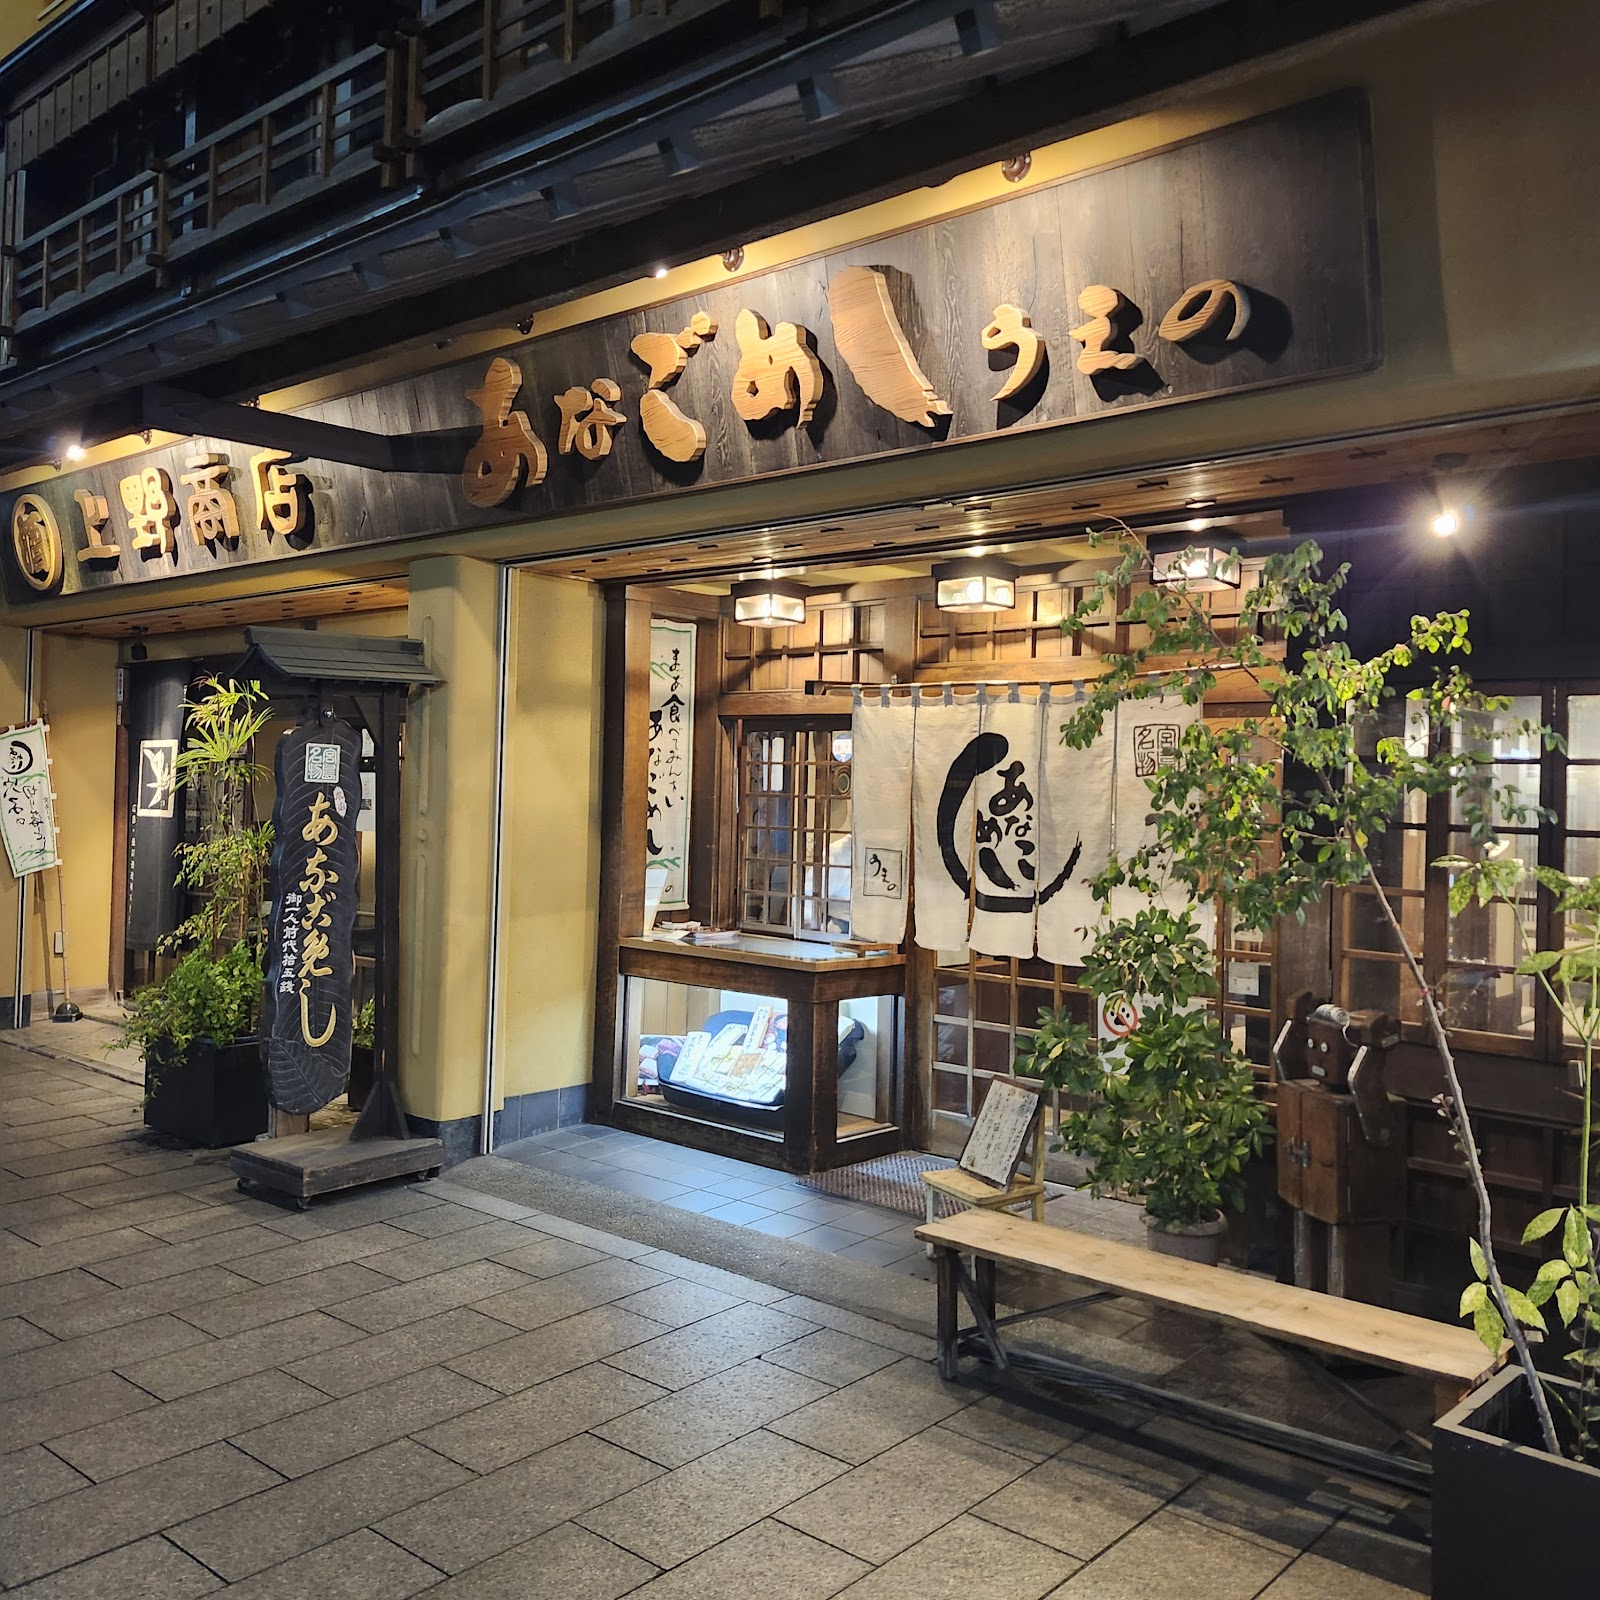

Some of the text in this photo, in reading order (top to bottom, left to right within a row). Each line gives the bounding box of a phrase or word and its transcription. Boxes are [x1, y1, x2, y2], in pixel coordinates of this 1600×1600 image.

[462, 264, 1250, 508] あなごめし うえの
[74, 446, 296, 562] 上野商店
